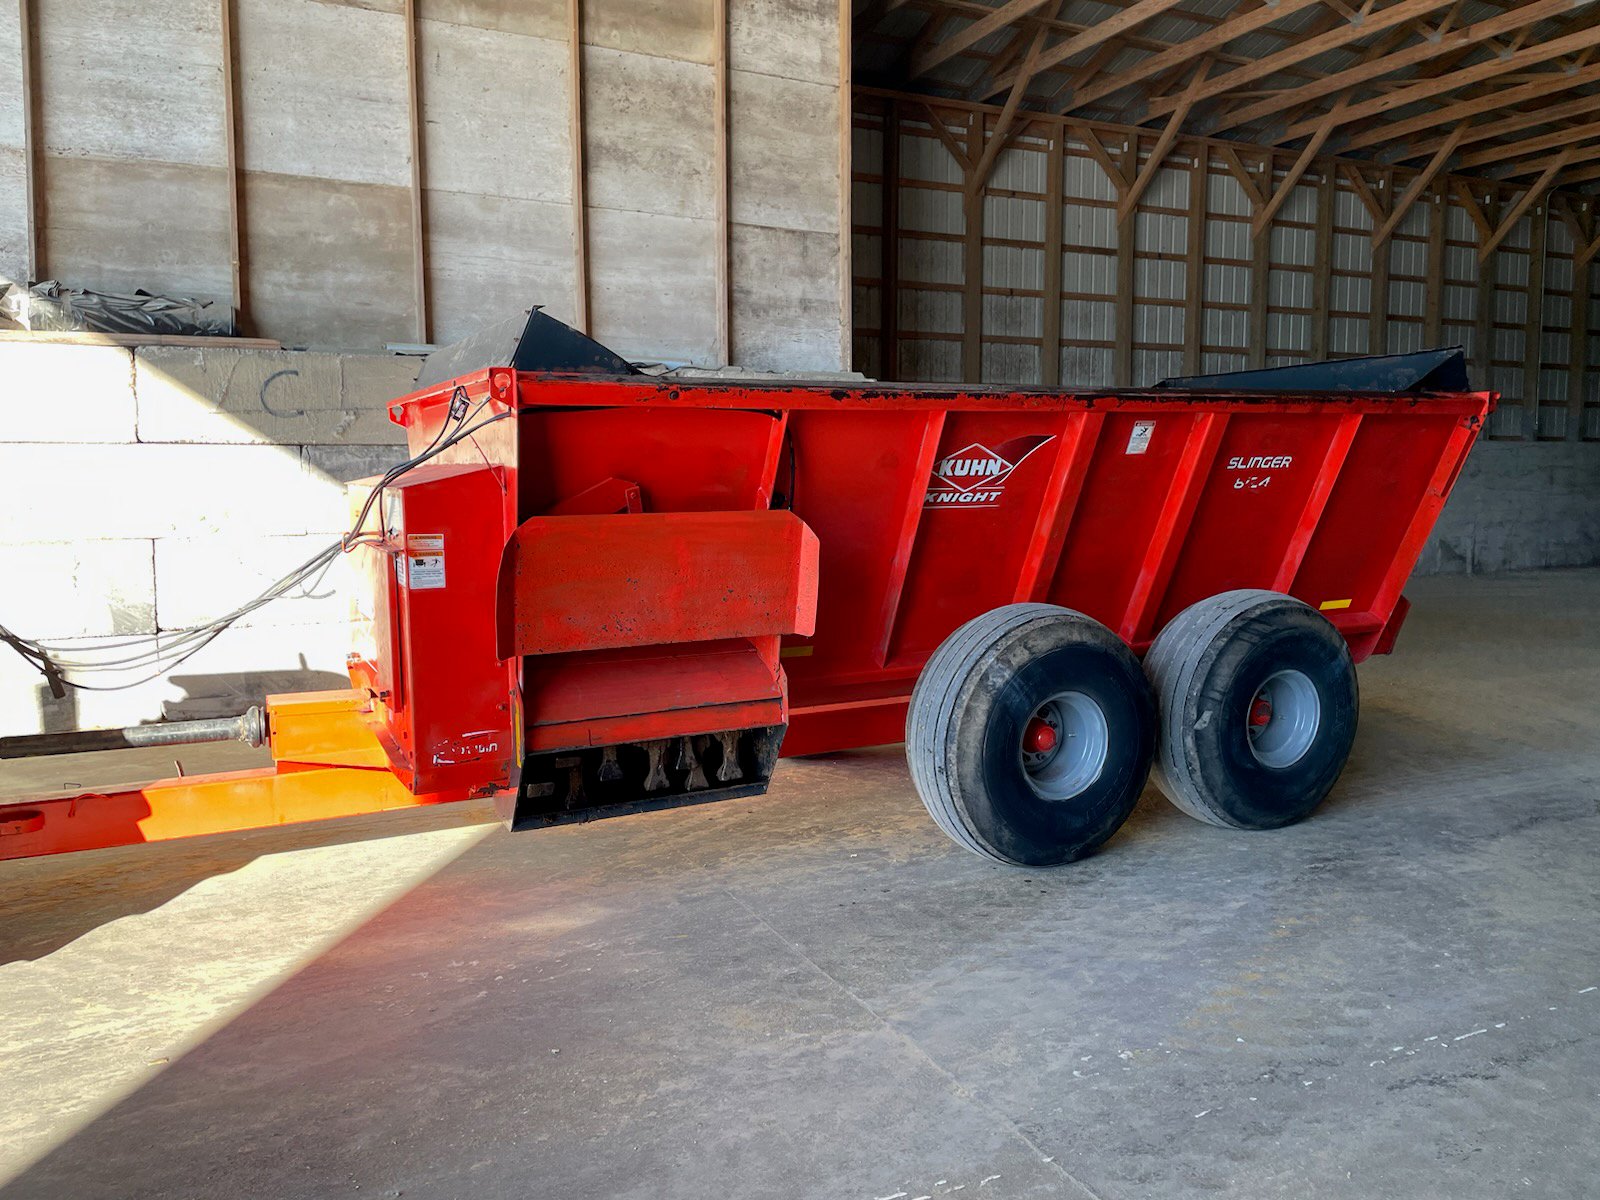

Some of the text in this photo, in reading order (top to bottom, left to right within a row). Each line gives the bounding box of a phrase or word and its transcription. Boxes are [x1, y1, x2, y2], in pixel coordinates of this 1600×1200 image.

[939, 459, 1002, 477] KUHN
[1226, 455, 1293, 469] SLINGER
[924, 491, 1002, 503] KNIGHT
